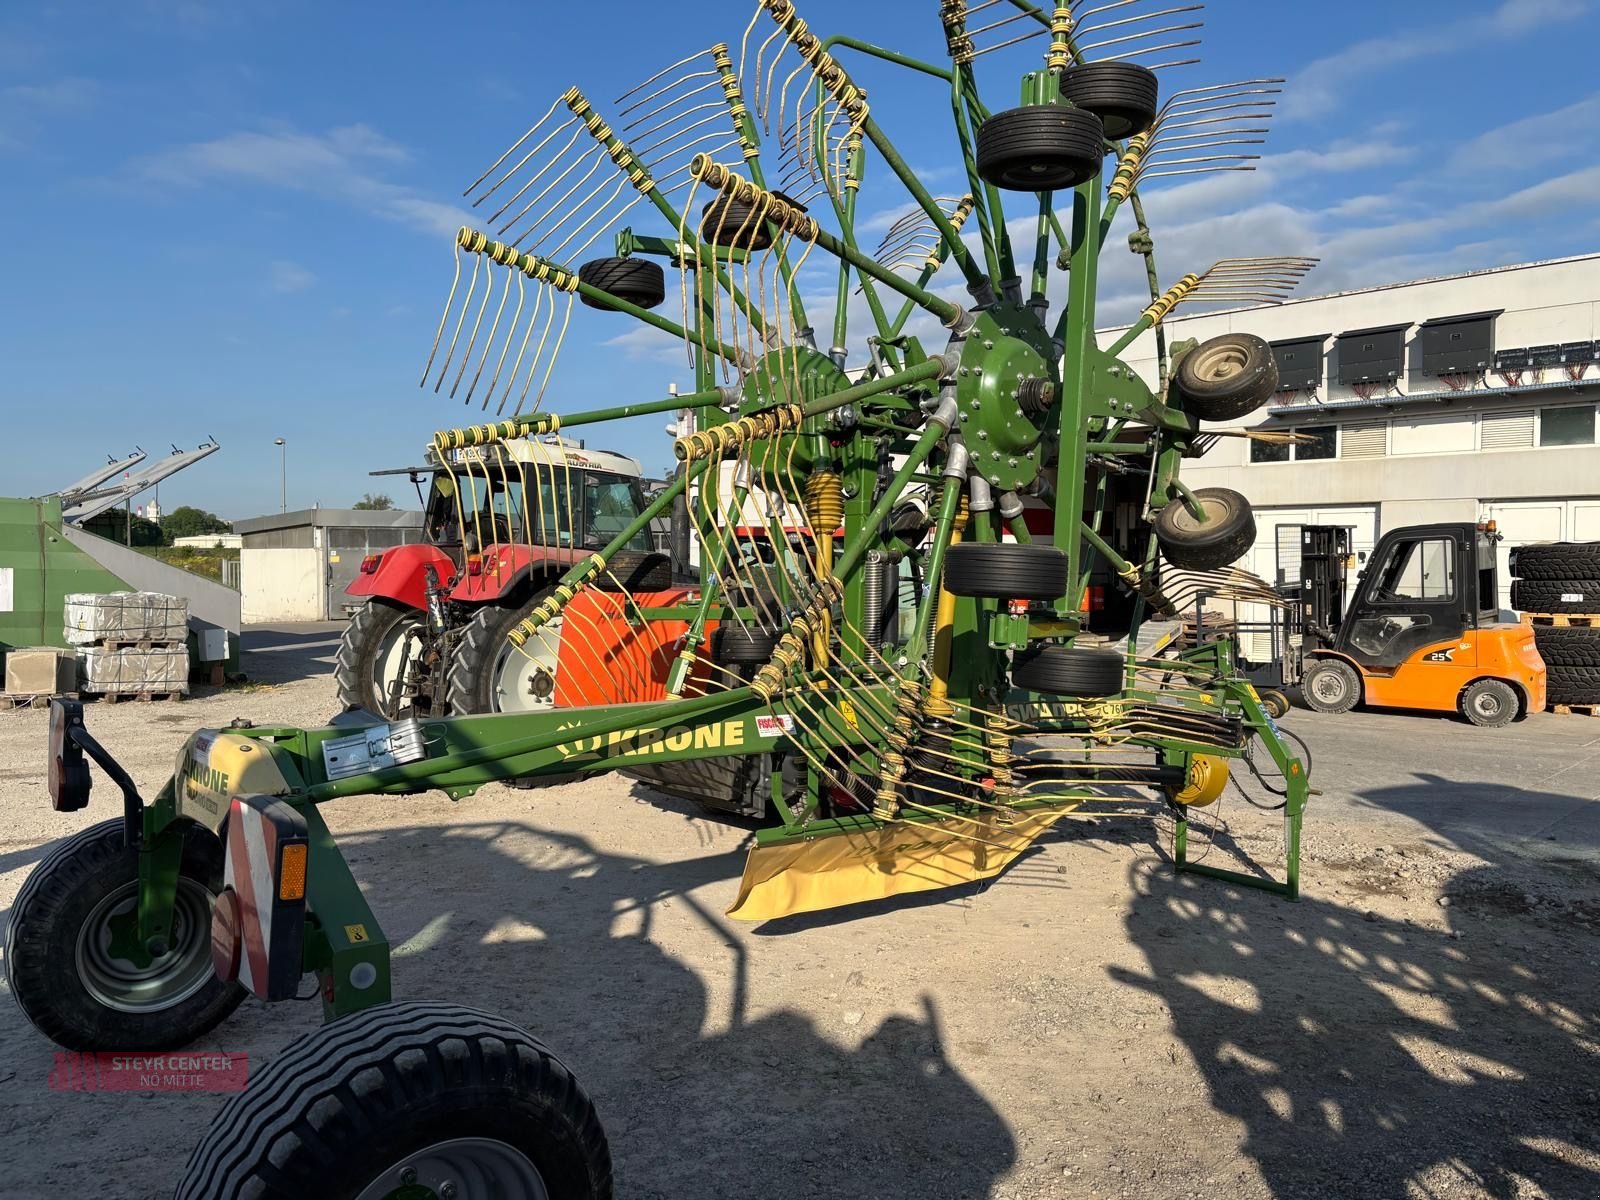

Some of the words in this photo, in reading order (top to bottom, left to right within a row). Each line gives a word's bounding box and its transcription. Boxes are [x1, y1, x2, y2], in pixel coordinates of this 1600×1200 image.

[1432, 653, 1445, 661] 25
[1008, 703, 1097, 721] SWADR
[608, 720, 744, 757] KRONE
